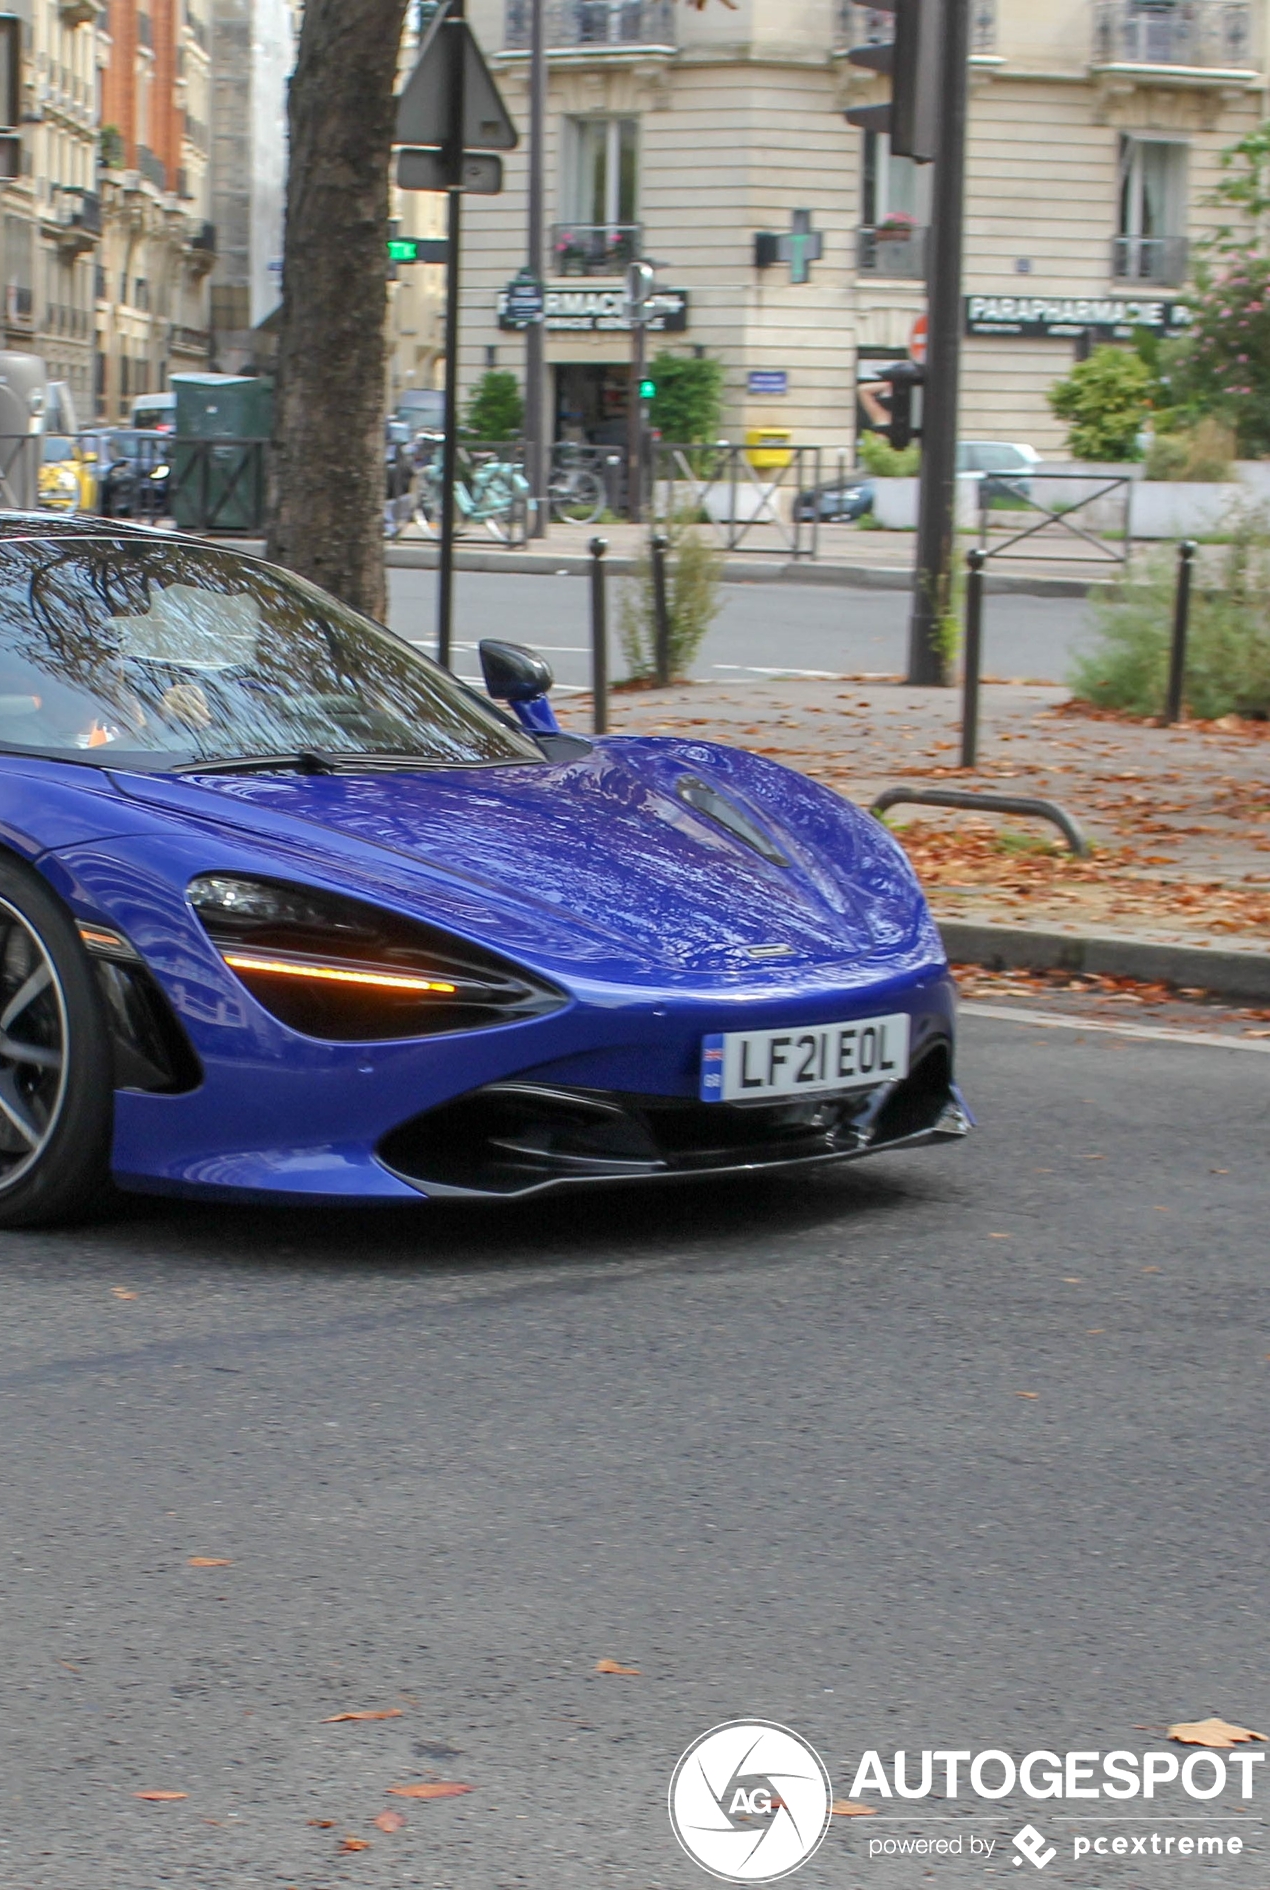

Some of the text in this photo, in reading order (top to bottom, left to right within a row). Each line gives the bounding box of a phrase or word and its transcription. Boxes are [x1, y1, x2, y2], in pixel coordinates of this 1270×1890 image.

[968, 297, 1164, 326] PARAPHARMACIE
[741, 1024, 896, 1088] LF21 EOL
